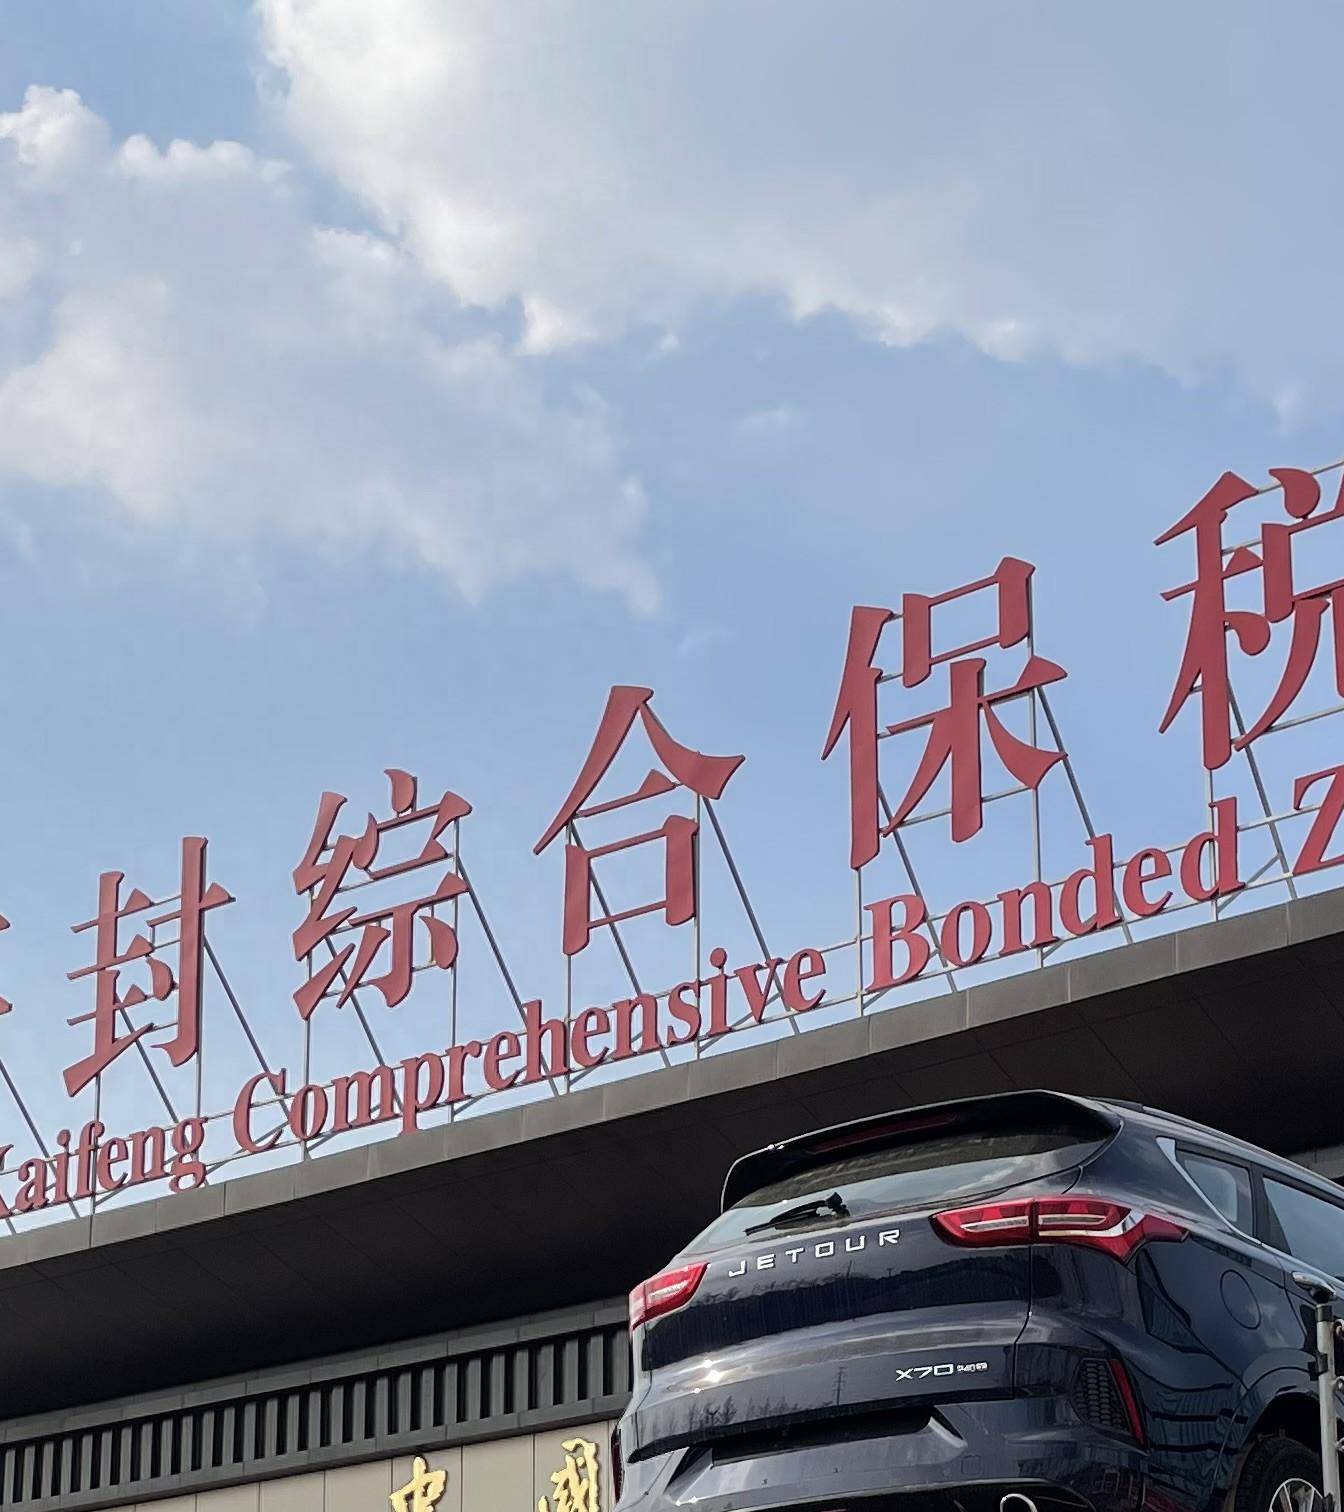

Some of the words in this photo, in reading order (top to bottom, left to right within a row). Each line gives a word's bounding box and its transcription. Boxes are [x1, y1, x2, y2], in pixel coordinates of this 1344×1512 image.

[233, 947, 827, 1153] Comprehensive
[863, 796, 1245, 994] Bonded
[727, 1228, 901, 1278] JETOUR
[895, 1363, 955, 1382] X70
